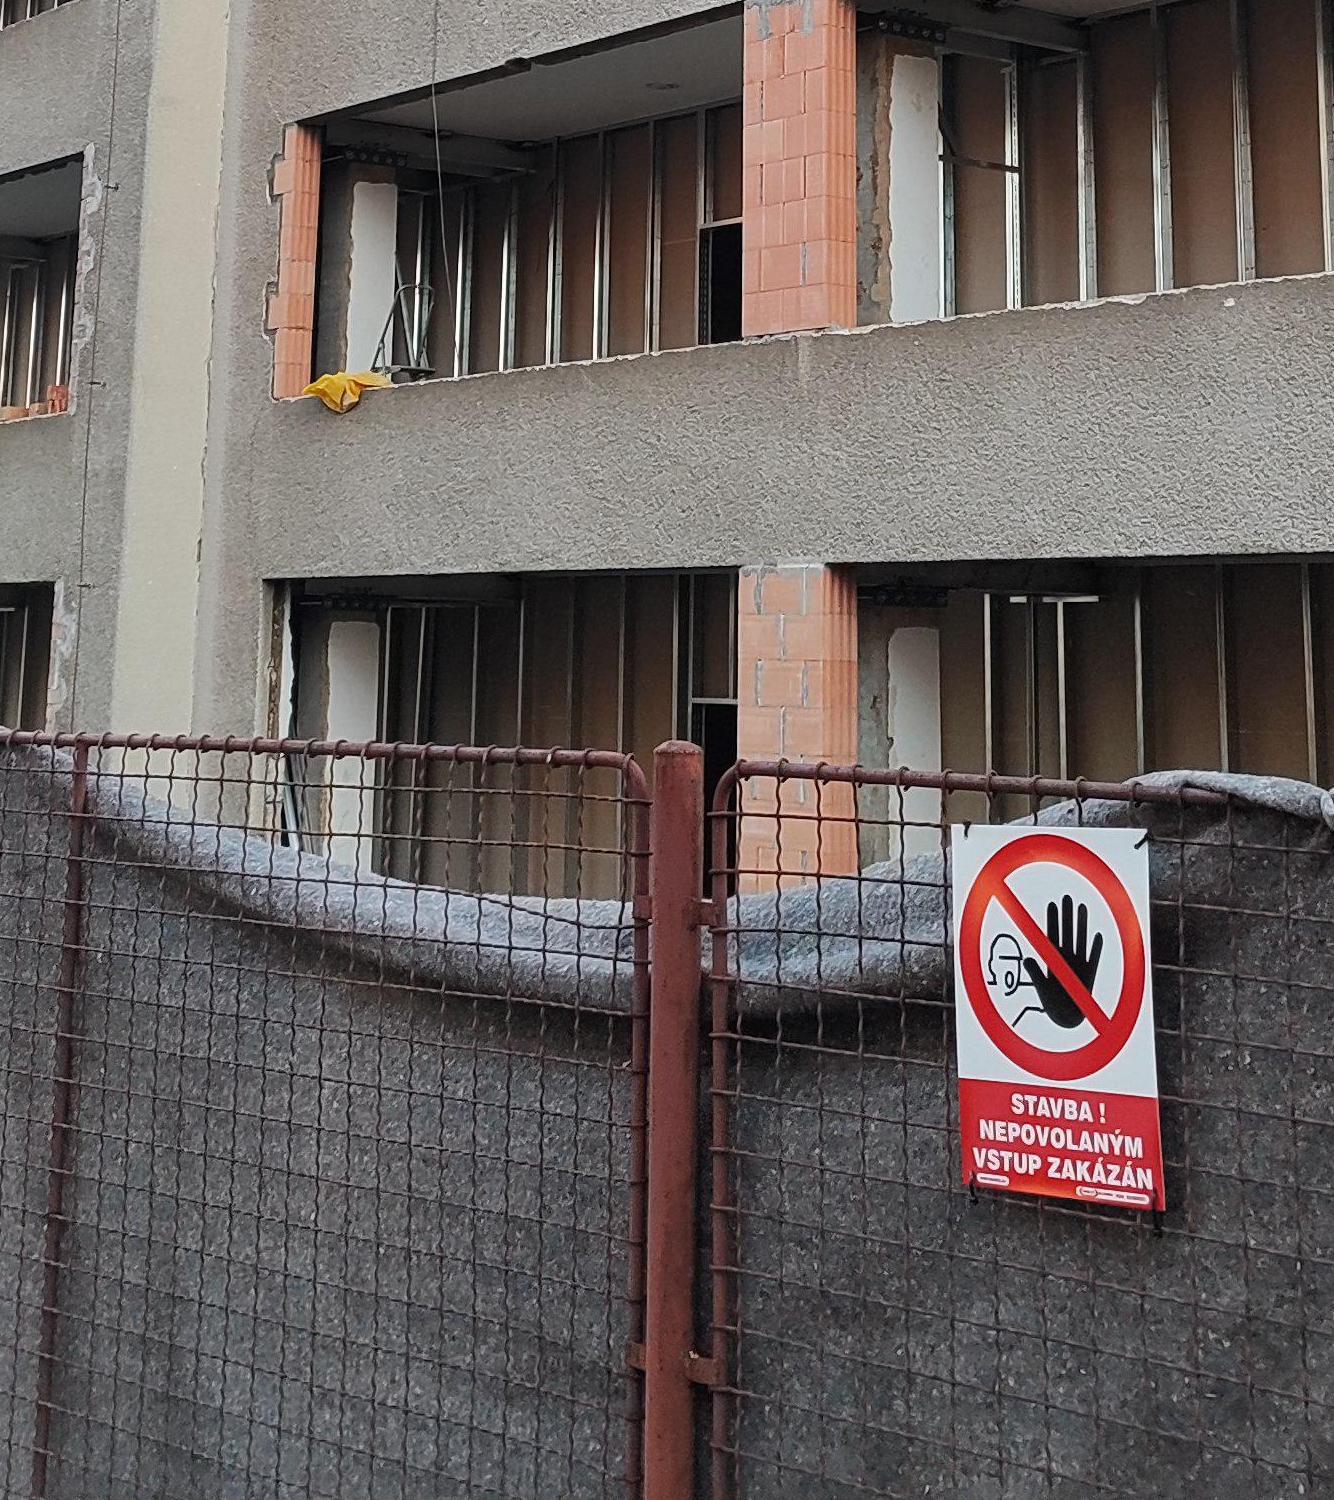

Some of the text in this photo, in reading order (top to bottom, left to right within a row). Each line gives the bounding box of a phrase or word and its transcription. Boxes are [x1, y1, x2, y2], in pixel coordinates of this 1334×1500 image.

[1011, 1093, 1106, 1124] STAVBA !
[979, 1118, 1143, 1158] NEPOVOLANÝM
[972, 1147, 1154, 1190] VSTUP ZAKÁZÁN
